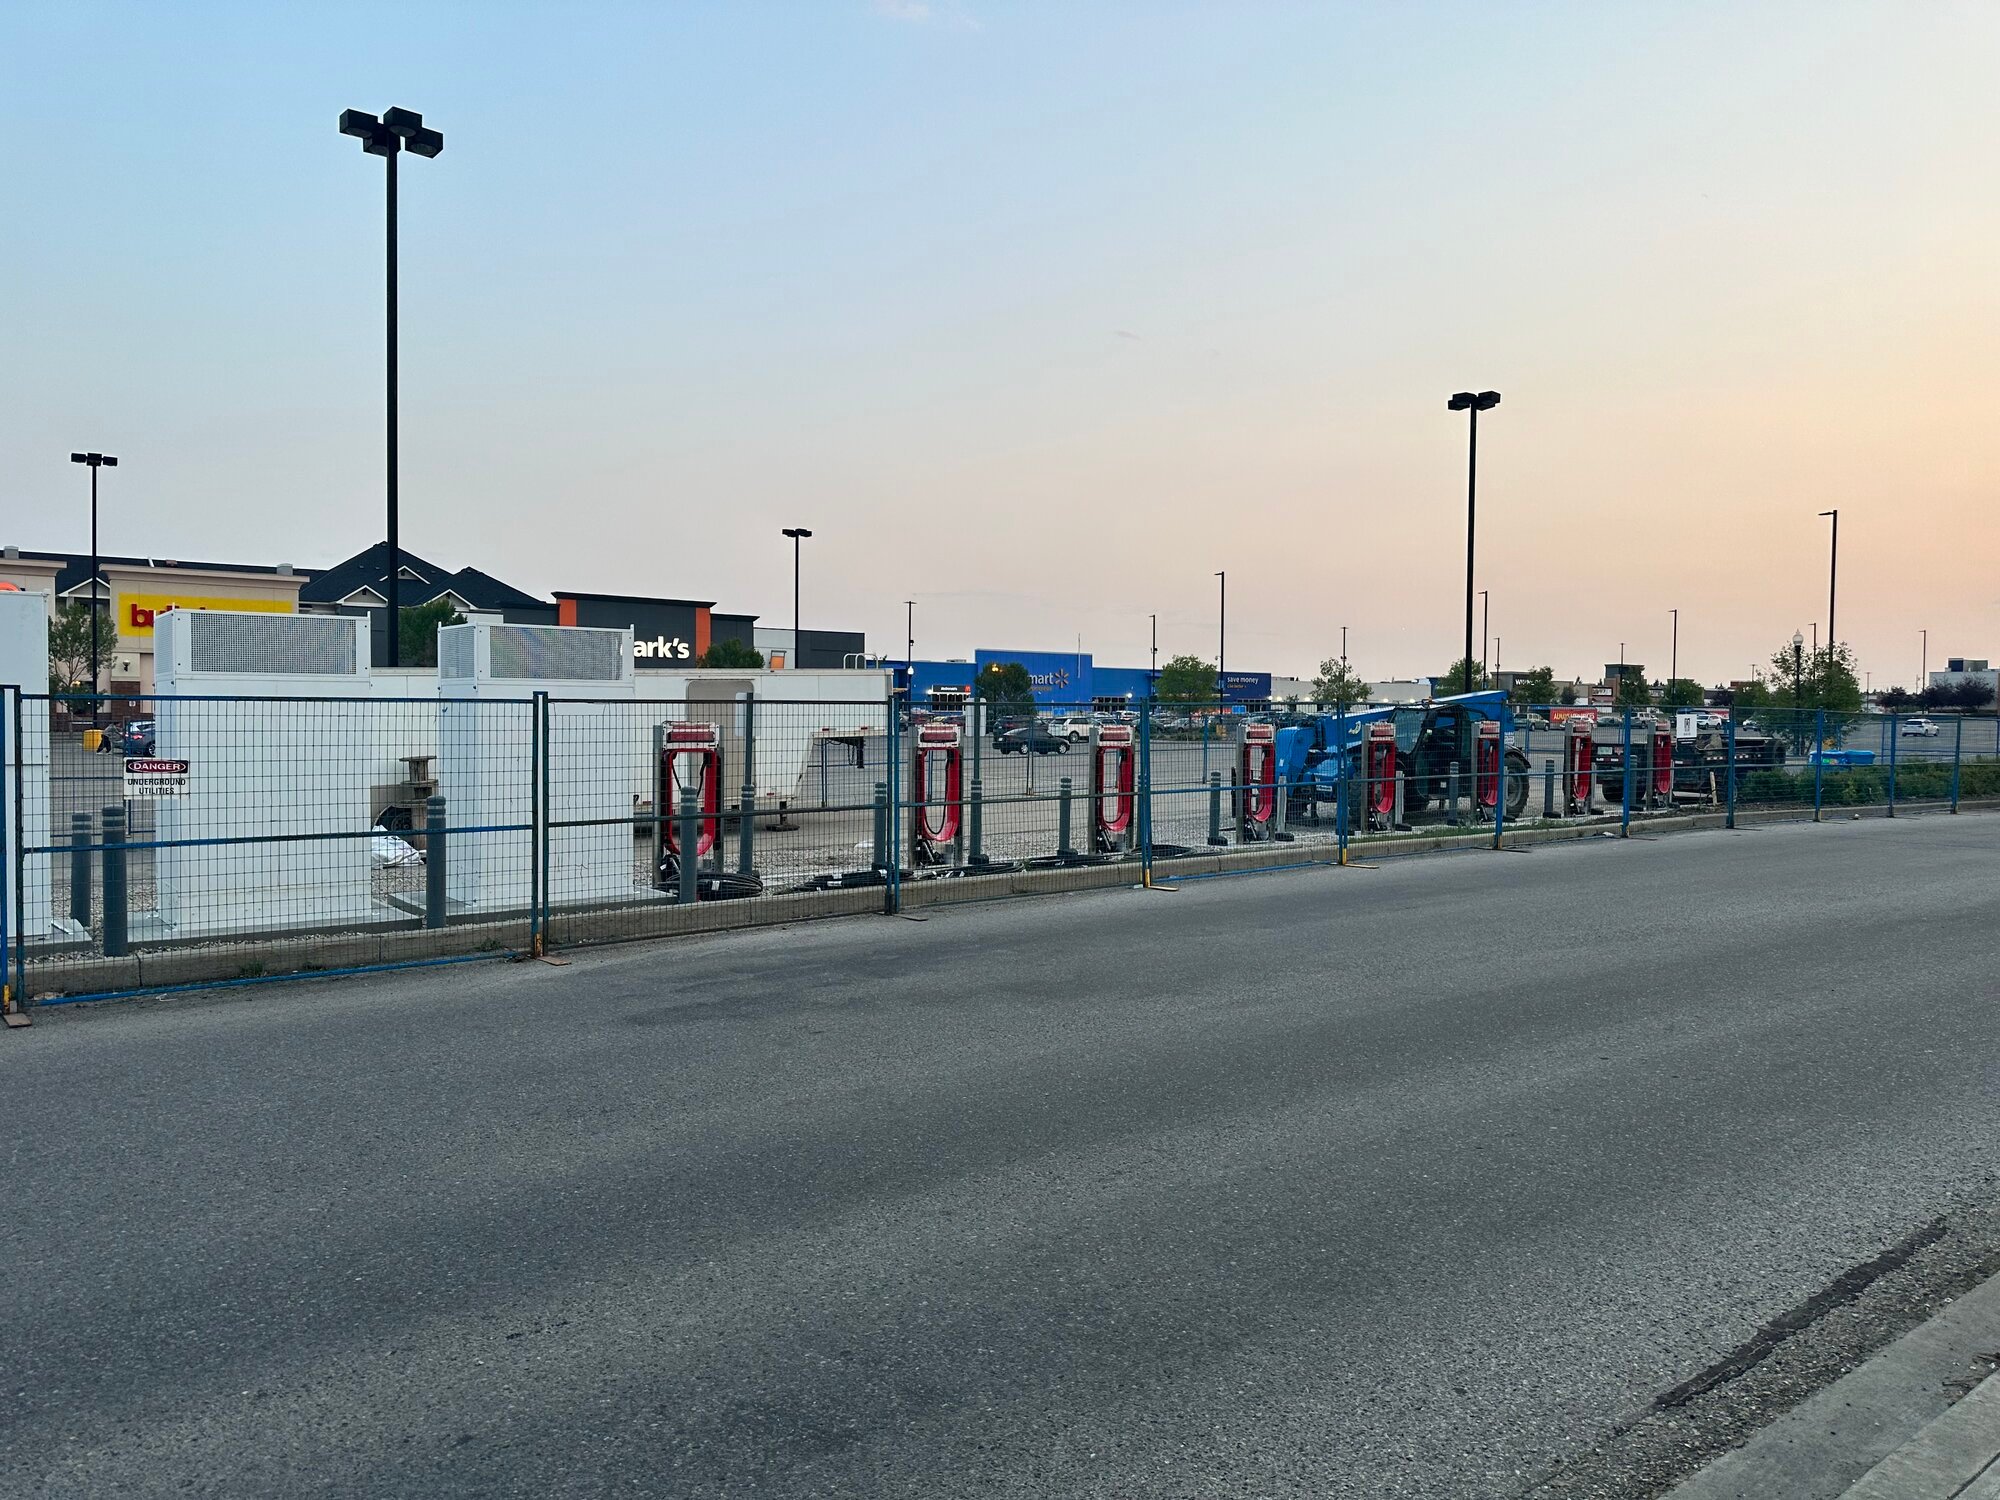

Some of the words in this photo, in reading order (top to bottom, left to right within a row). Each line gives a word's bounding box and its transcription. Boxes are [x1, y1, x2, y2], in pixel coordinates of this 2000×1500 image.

[620, 636, 690, 659] ark's
[1027, 672, 1054, 684] mart
[127, 778, 186, 786] UNDERGROUND
[138, 787, 175, 795] UTILITIES
